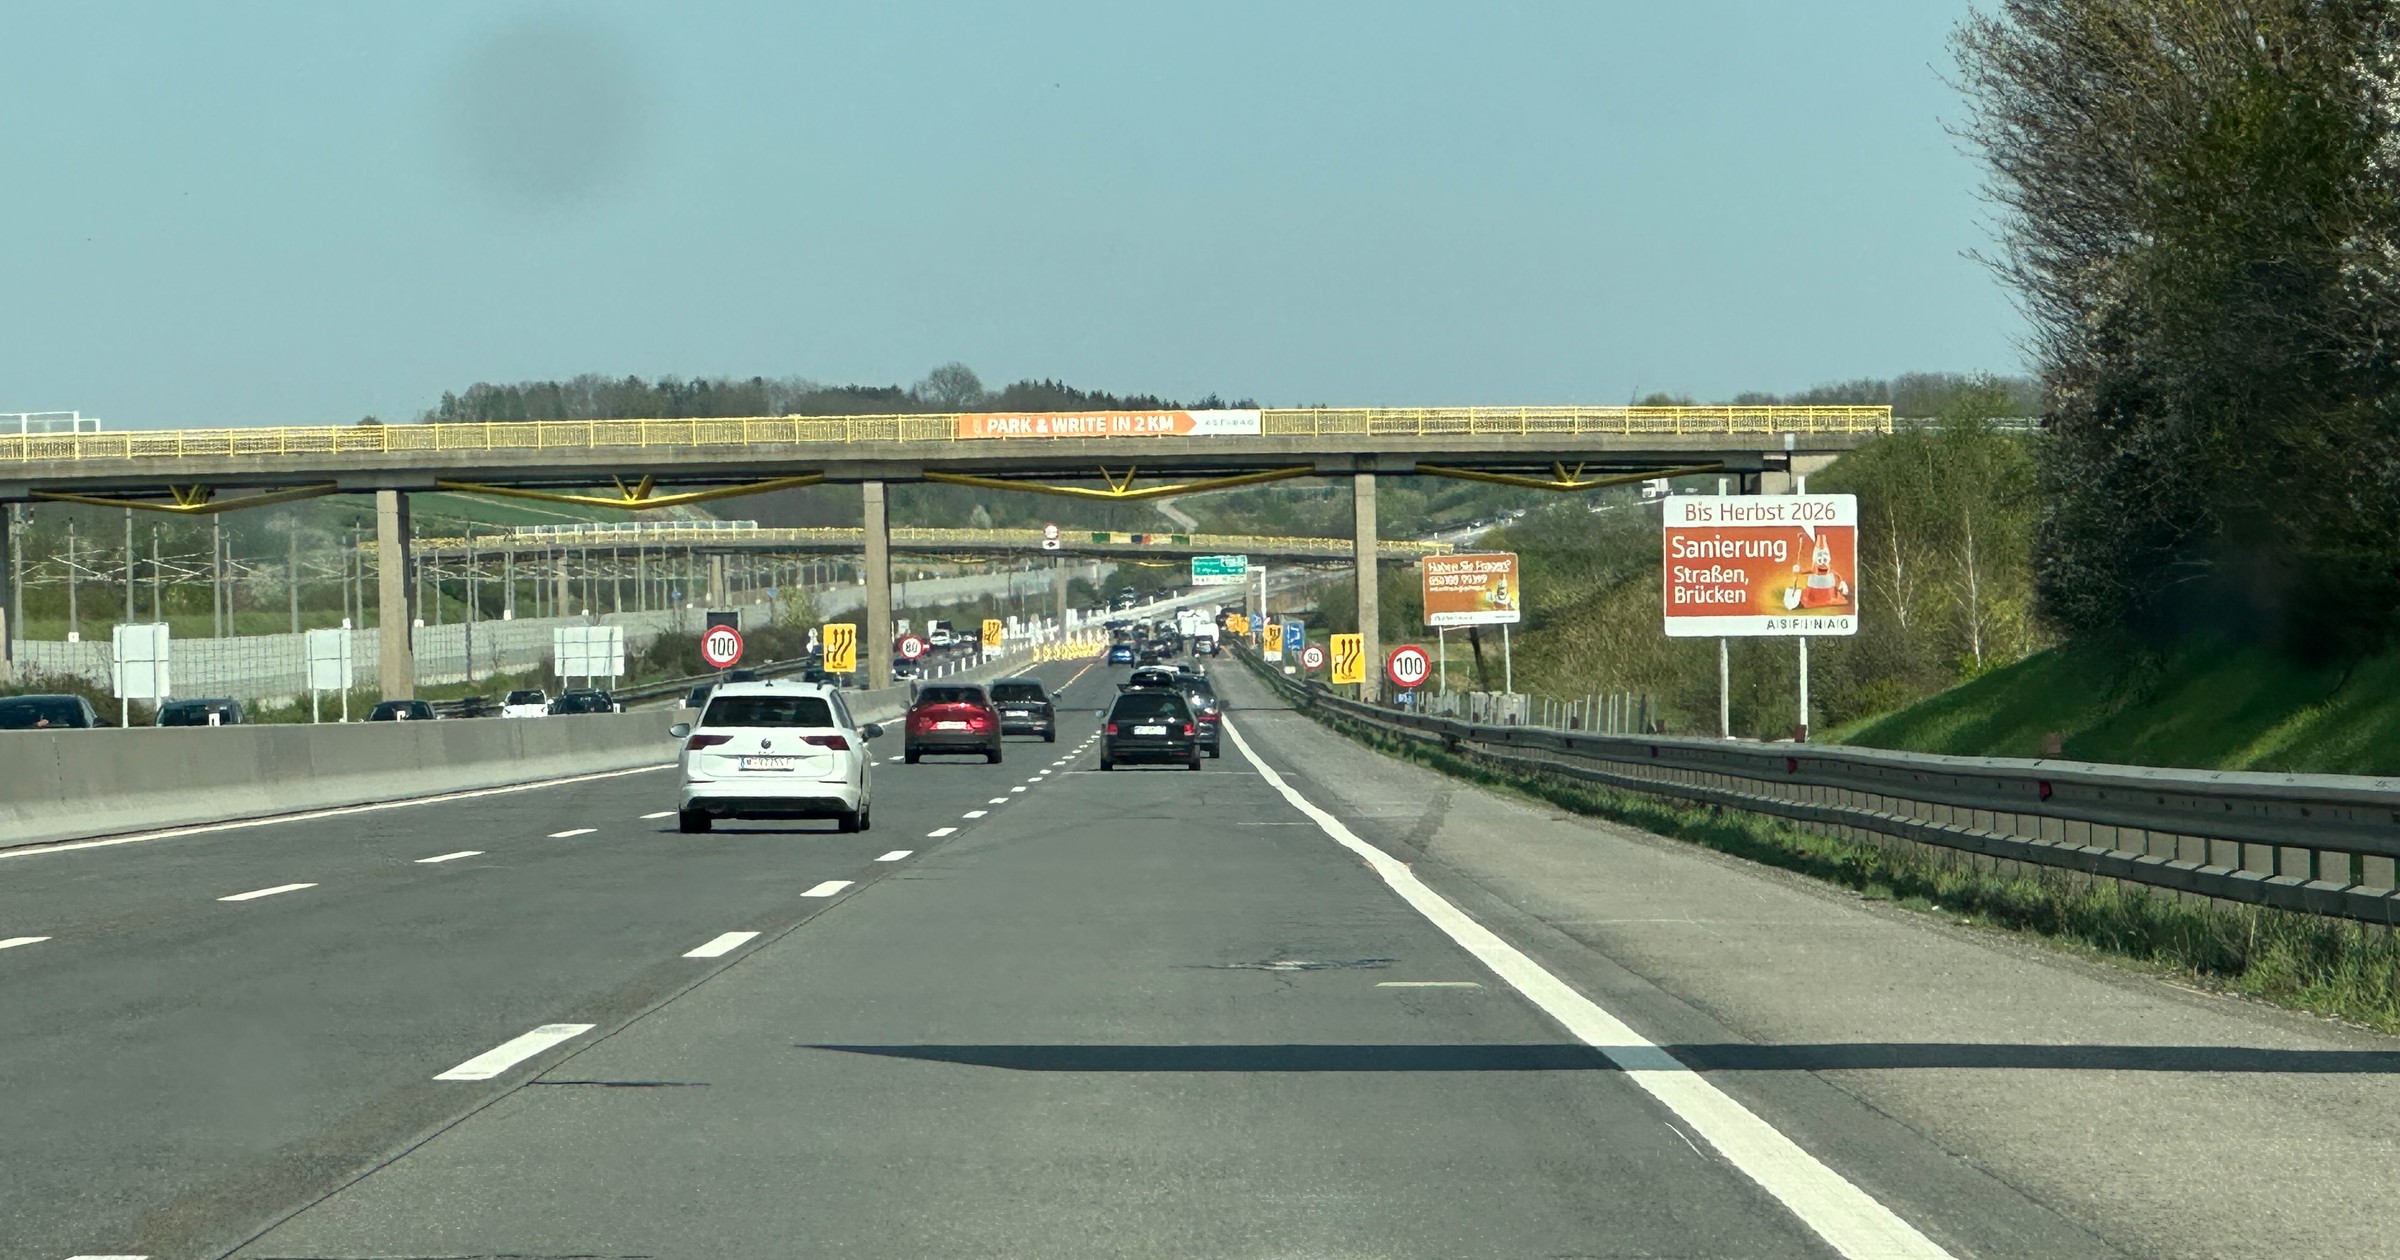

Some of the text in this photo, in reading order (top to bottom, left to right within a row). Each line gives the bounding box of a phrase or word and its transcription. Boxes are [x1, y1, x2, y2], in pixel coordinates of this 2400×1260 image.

[987, 417, 1032, 434] PARK
[1035, 418, 1049, 433] &
[1051, 416, 1107, 433] WRITE
[1112, 416, 1131, 432] IN
[1685, 501, 1836, 521] Bis Herbst 2026
[1671, 534, 1787, 563] Sanierung
[1673, 565, 1749, 586] Straßen,
[1674, 586, 1747, 604] Brücken
[710, 637, 735, 657] 100
[1396, 656, 1423, 676] 100
